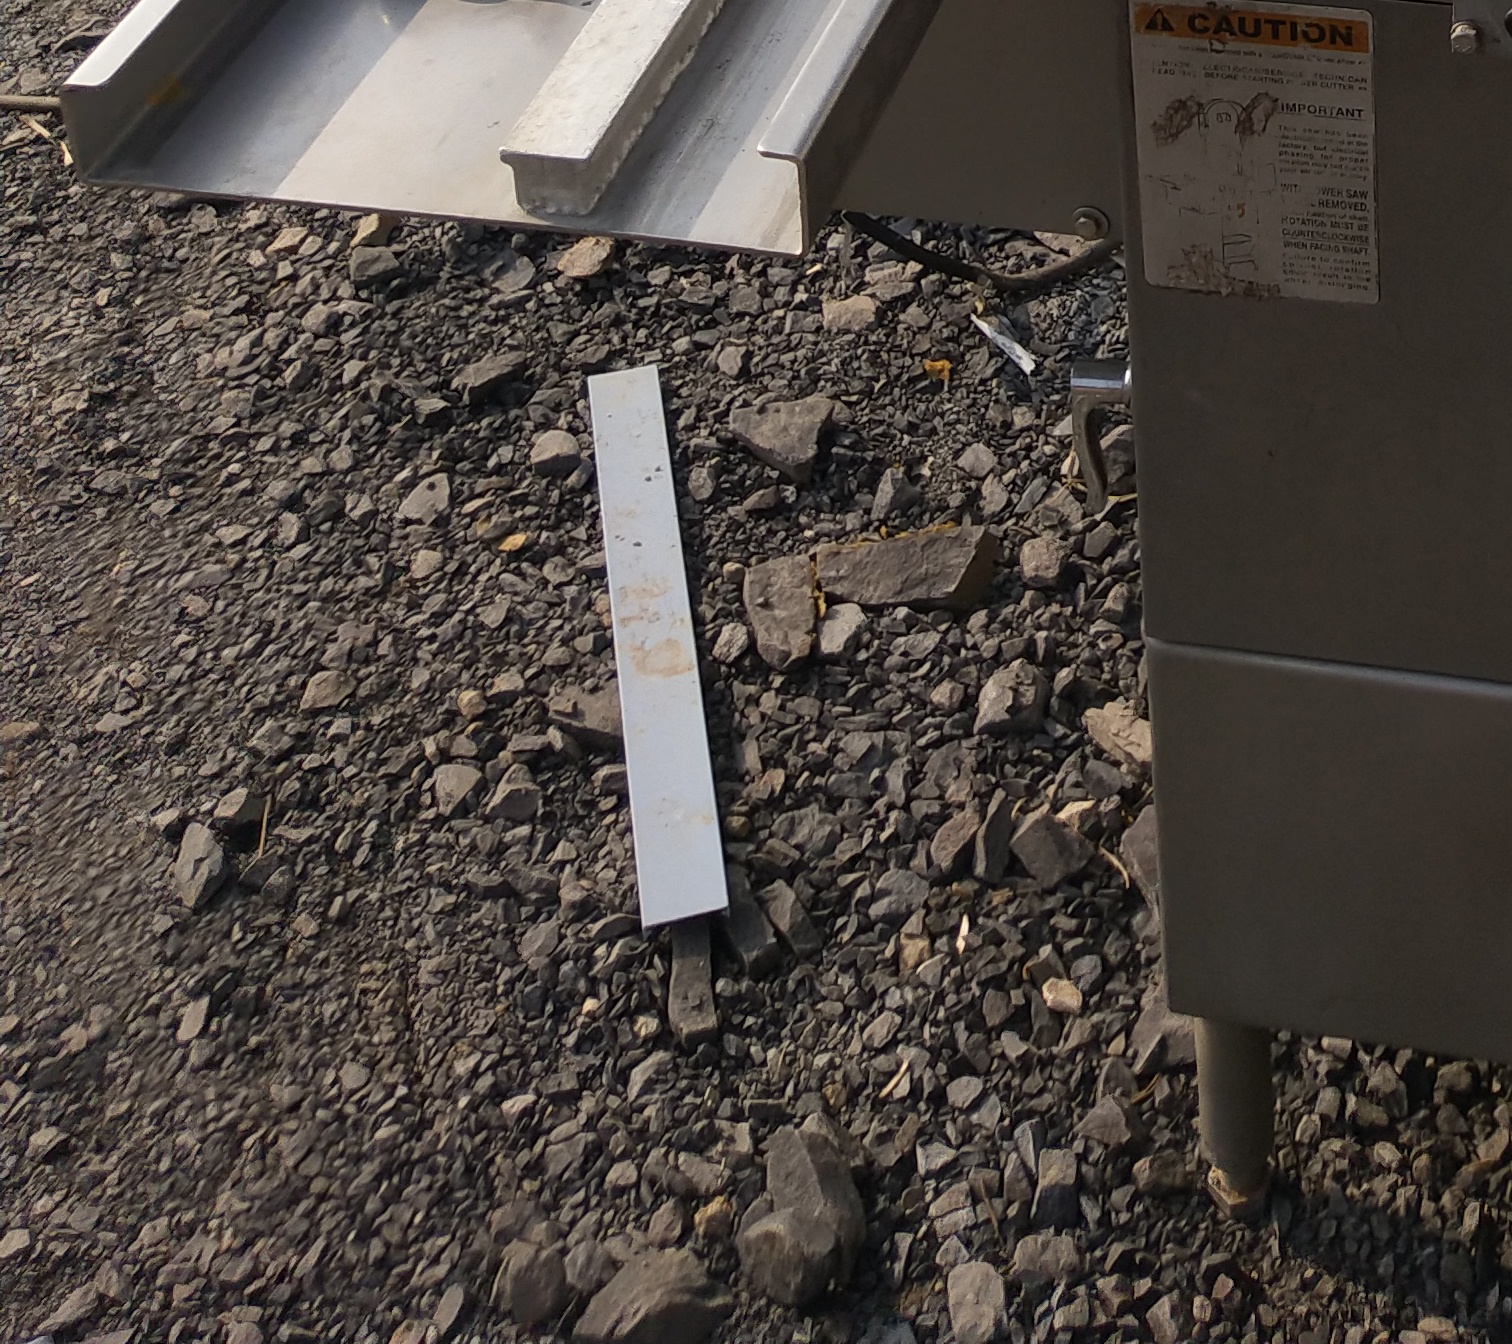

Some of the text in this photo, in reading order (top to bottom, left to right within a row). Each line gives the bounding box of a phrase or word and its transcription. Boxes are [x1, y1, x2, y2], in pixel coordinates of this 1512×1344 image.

[1187, 12, 1354, 47] CAUTION
[1281, 103, 1364, 117] IMPORTANT
[1345, 189, 1369, 200] SAW
[1281, 216, 1327, 228] ROTATION
[1283, 240, 1308, 250] WHEN
